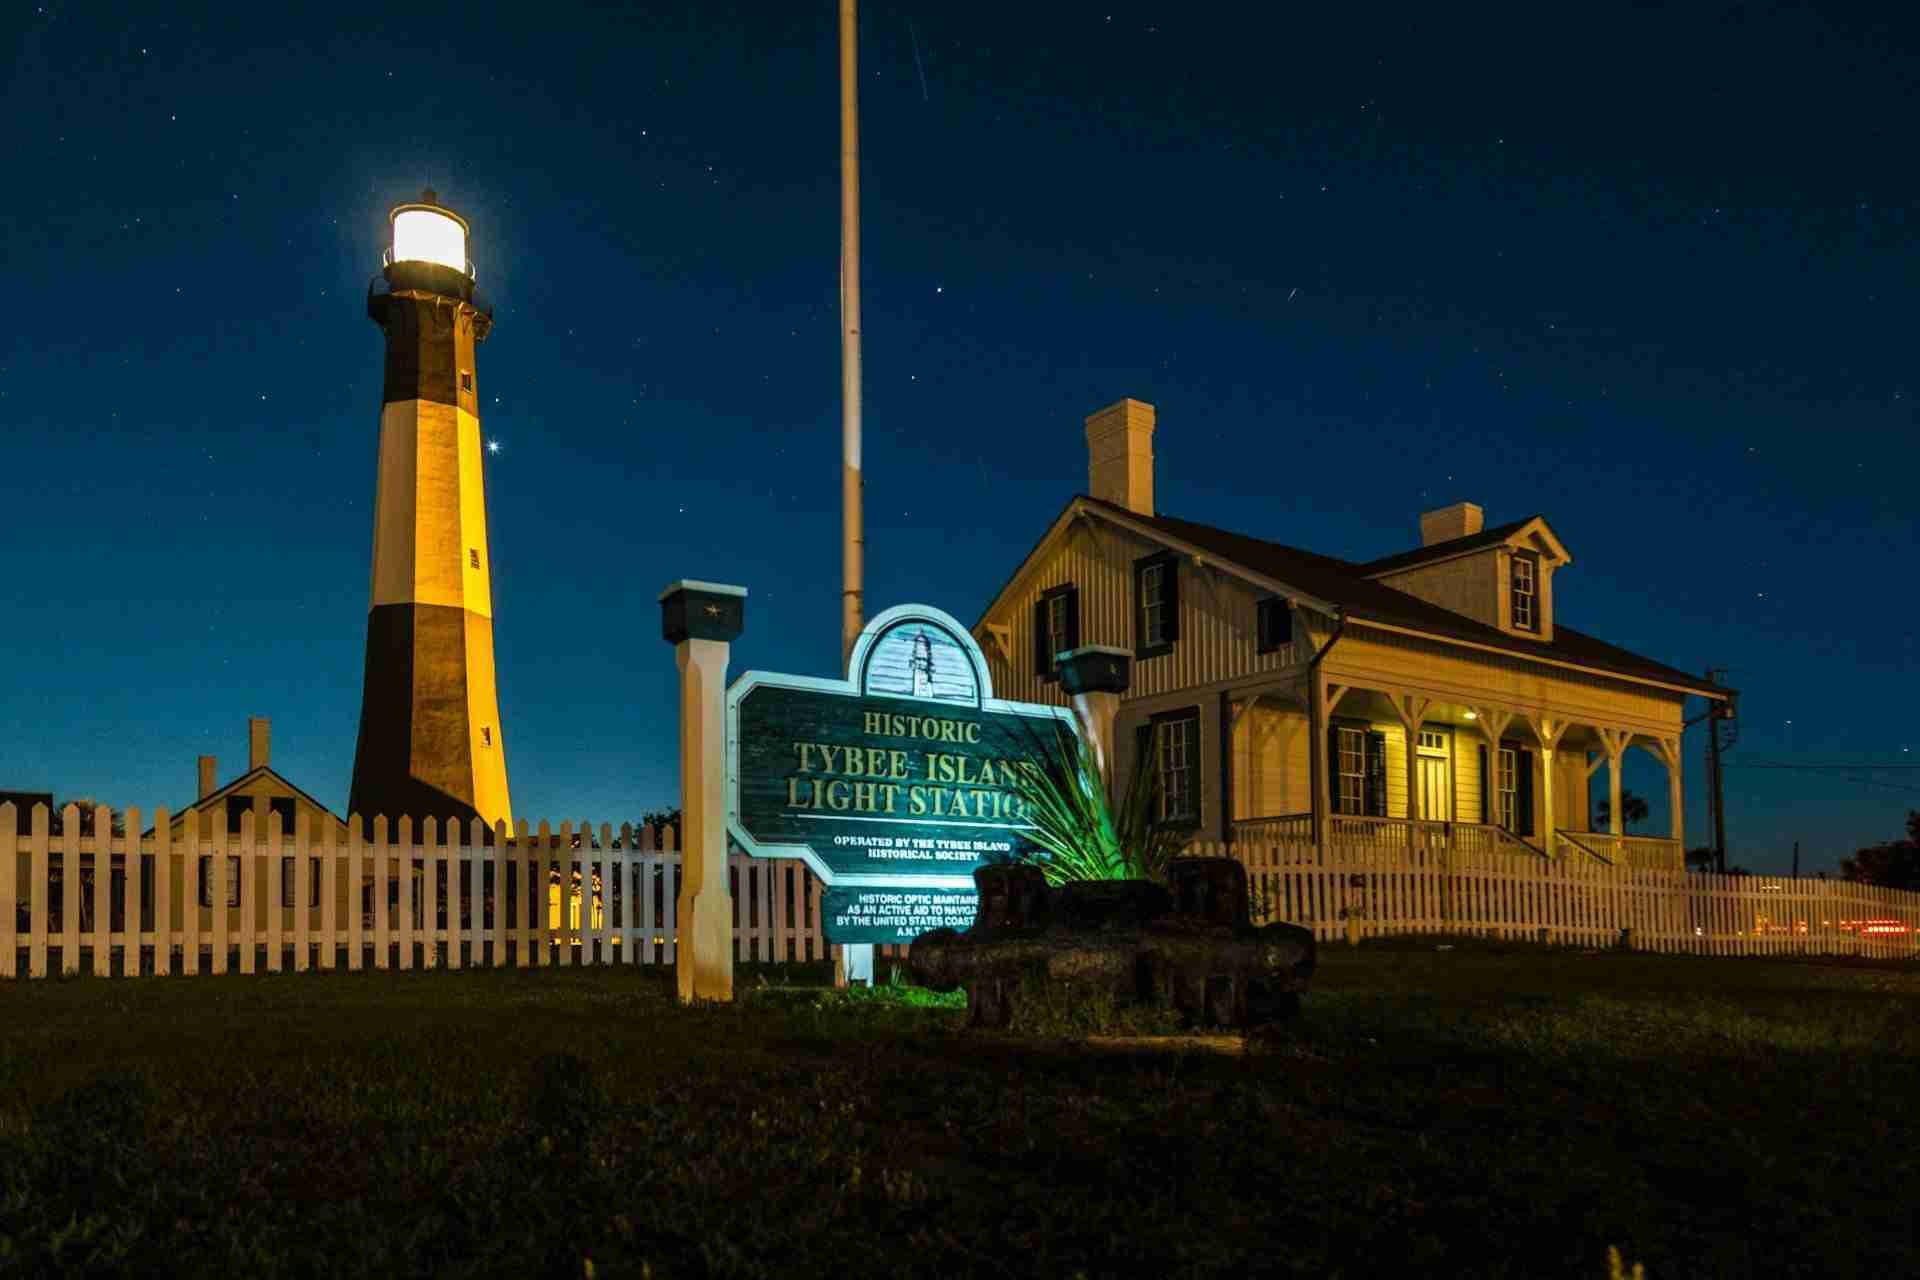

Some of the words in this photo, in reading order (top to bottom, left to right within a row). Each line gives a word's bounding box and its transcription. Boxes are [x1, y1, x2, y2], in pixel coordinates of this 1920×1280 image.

[864, 712, 981, 744] HISTORIC
[793, 742, 908, 779] TYBEE
[786, 777, 900, 813] LIGHT
[909, 786, 1031, 820] STATIO
[834, 835, 893, 847] OPERATED
[895, 837, 910, 848] BY
[912, 838, 935, 849] THE
[936, 840, 971, 850] TYBEE
[973, 841, 1010, 852] ISLAND
[868, 848, 933, 860] HISTORICAL
[935, 851, 980, 861] SOCIETY
[859, 893, 903, 905] HISTORIC
[904, 894, 932, 905] OPTIC
[933, 895, 979, 906] MAINTAINE
[847, 904, 861, 915] AS
[863, 904, 876, 915] AN
[878, 905, 912, 916] ACTIVE
[913, 905, 929, 916] AID
[931, 906, 943, 916] TO
[944, 906, 977, 916] NAVIGA
[836, 915, 850, 927] BY
[852, 915, 872, 927] THE
[873, 915, 907, 927] UNITED
[908, 916, 944, 927] STATES
[945, 916, 975, 927] COAST
